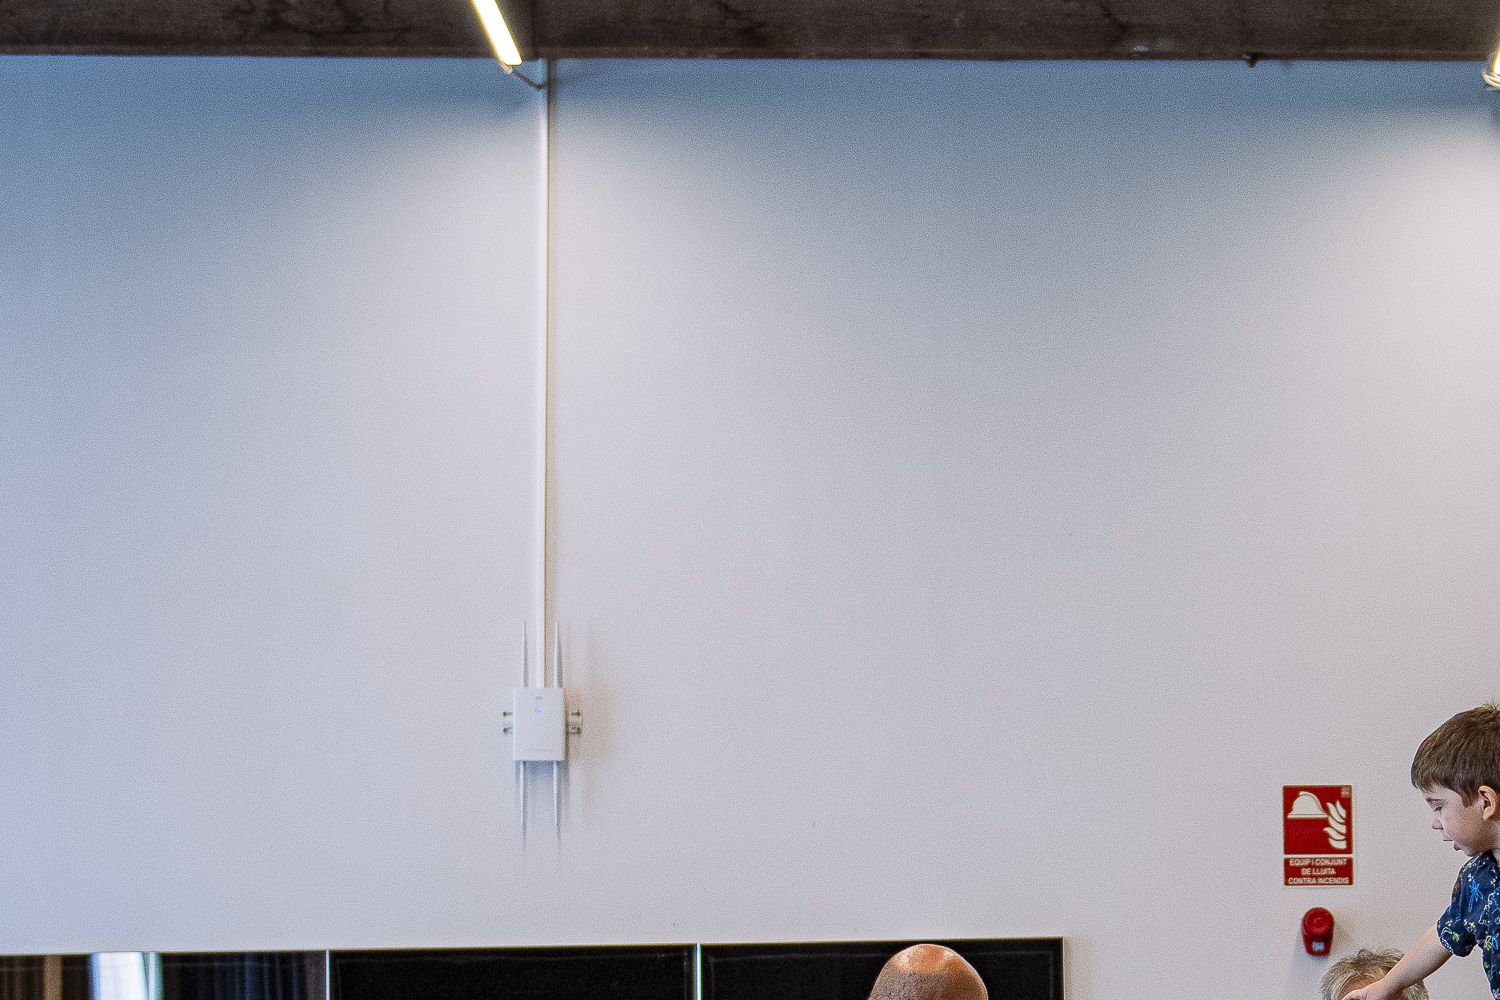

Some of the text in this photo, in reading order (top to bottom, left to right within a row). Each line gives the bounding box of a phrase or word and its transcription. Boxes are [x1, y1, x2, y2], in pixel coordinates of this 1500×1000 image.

[1289, 858, 1311, 866] EQUIP
[1315, 858, 1347, 866] CONJUNT
[1301, 867, 1336, 875] DE LLUITA
[1288, 877, 1349, 885] CONTRA INCENDIS
